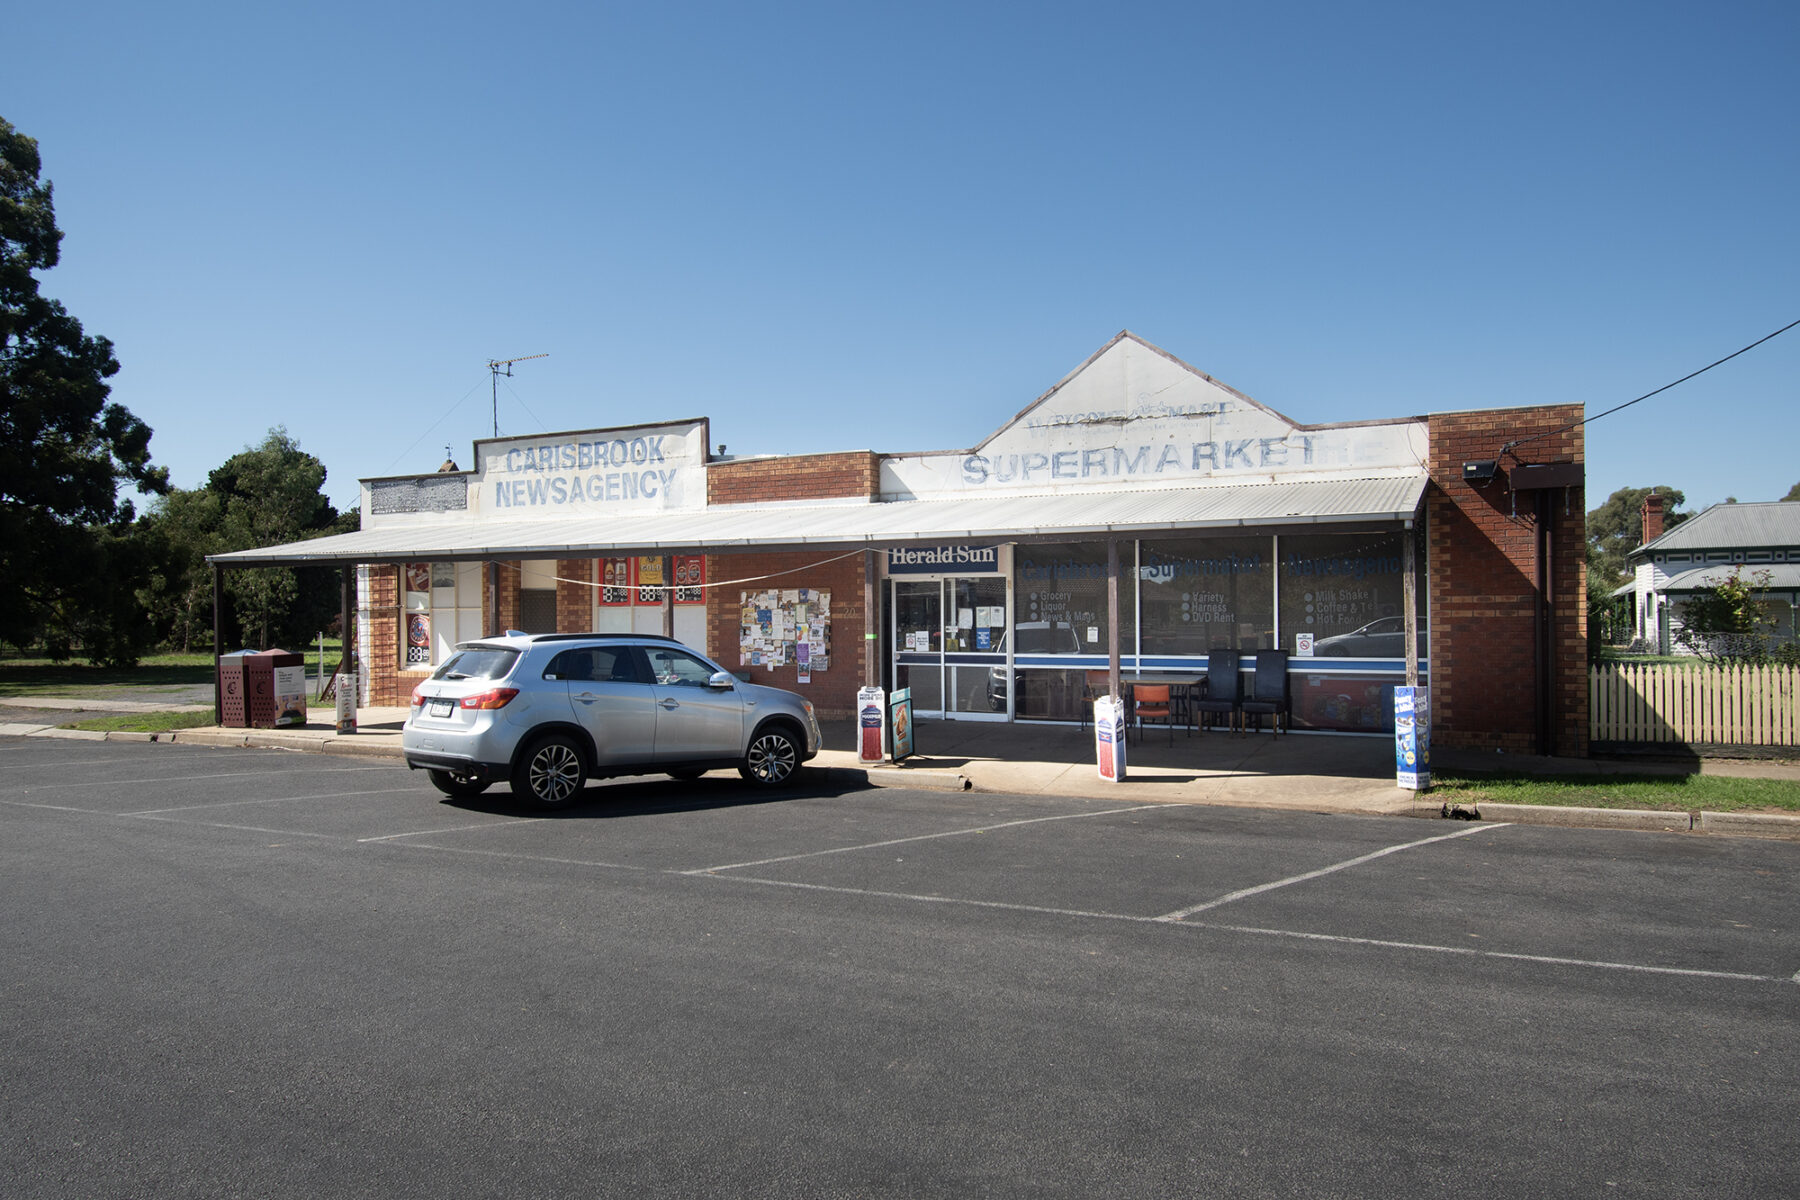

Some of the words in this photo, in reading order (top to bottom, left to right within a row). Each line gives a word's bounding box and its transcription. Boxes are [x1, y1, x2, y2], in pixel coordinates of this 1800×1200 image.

[506, 436, 665, 473] CARISBROOK
[963, 435, 1317, 484] SUPERMARKET
[495, 468, 677, 508] NEWSAGENCY
[892, 546, 953, 565] Herald
[956, 545, 995, 563] Sun
[1287, 552, 1402, 580] Newsagenc
[1040, 590, 1072, 602] Grocery
[1192, 592, 1225, 602] Variety
[1315, 590, 1336, 602] Milk
[1338, 588, 1369, 601] Shake
[1040, 601, 1067, 612] Liquor
[1191, 602, 1228, 612] Harness
[1316, 601, 1348, 613] Coffee
[1350, 603, 1358, 614] &
[1040, 610, 1064, 622] News
[1065, 610, 1072, 621] &
[1192, 611, 1212, 623] DVD
[1214, 612, 1235, 623] Rent
[1316, 613, 1334, 625] Hot
[1338, 613, 1362, 625] Food
